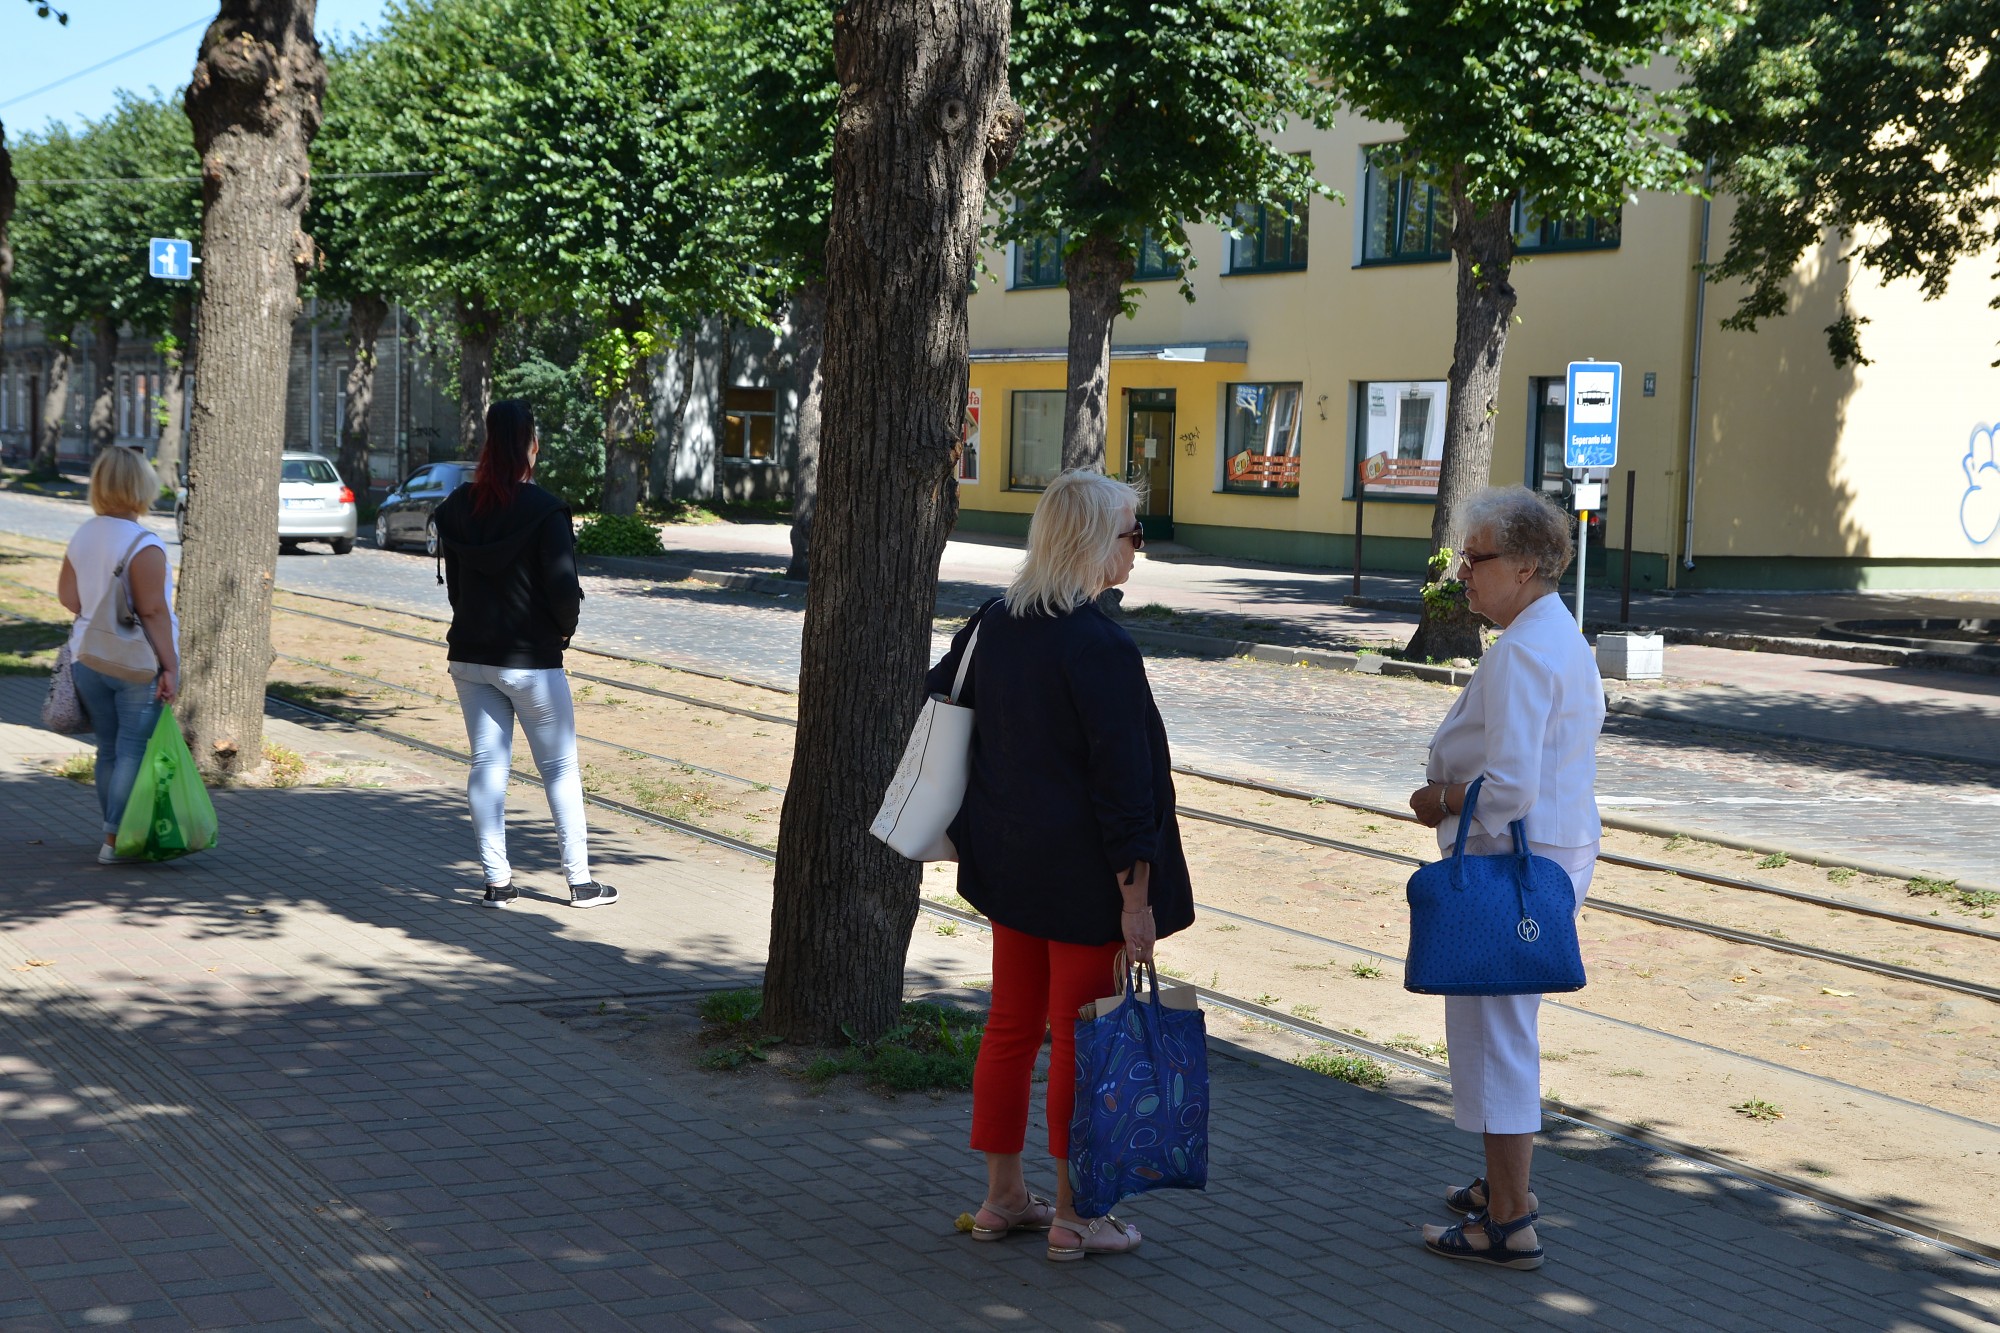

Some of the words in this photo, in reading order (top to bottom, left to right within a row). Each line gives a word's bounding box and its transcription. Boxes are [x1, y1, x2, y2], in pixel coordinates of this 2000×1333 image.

[968, 391, 980, 405] fa
[1572, 434, 1600, 447] Esperanto
[1601, 434, 1611, 444] iela
